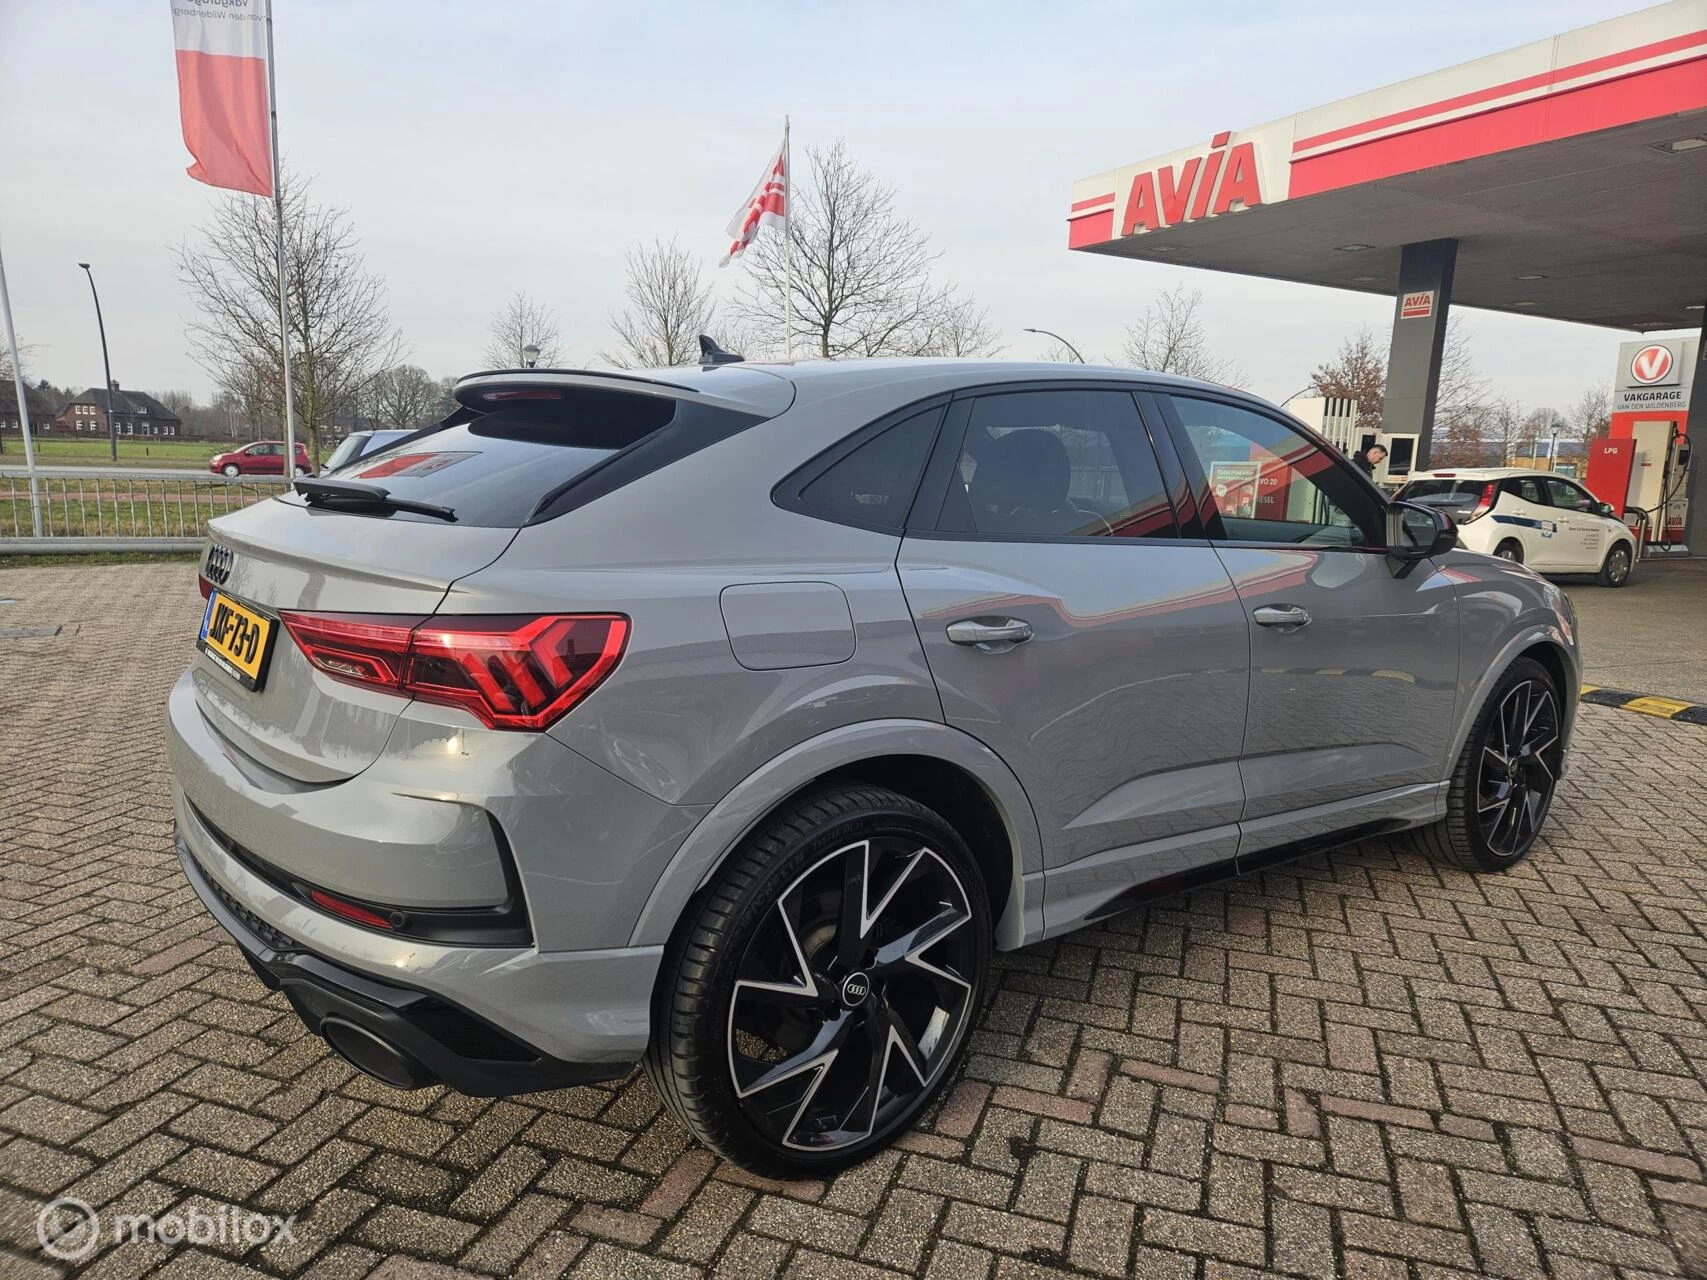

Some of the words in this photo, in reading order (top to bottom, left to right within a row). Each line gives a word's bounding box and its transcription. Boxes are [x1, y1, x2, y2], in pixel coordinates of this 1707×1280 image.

[1121, 131, 1262, 236] AVIA
[1404, 293, 1430, 307] AVIA
[1624, 391, 1682, 402] VAKGARAGE
[1645, 401, 1686, 409] WILDENBERG
